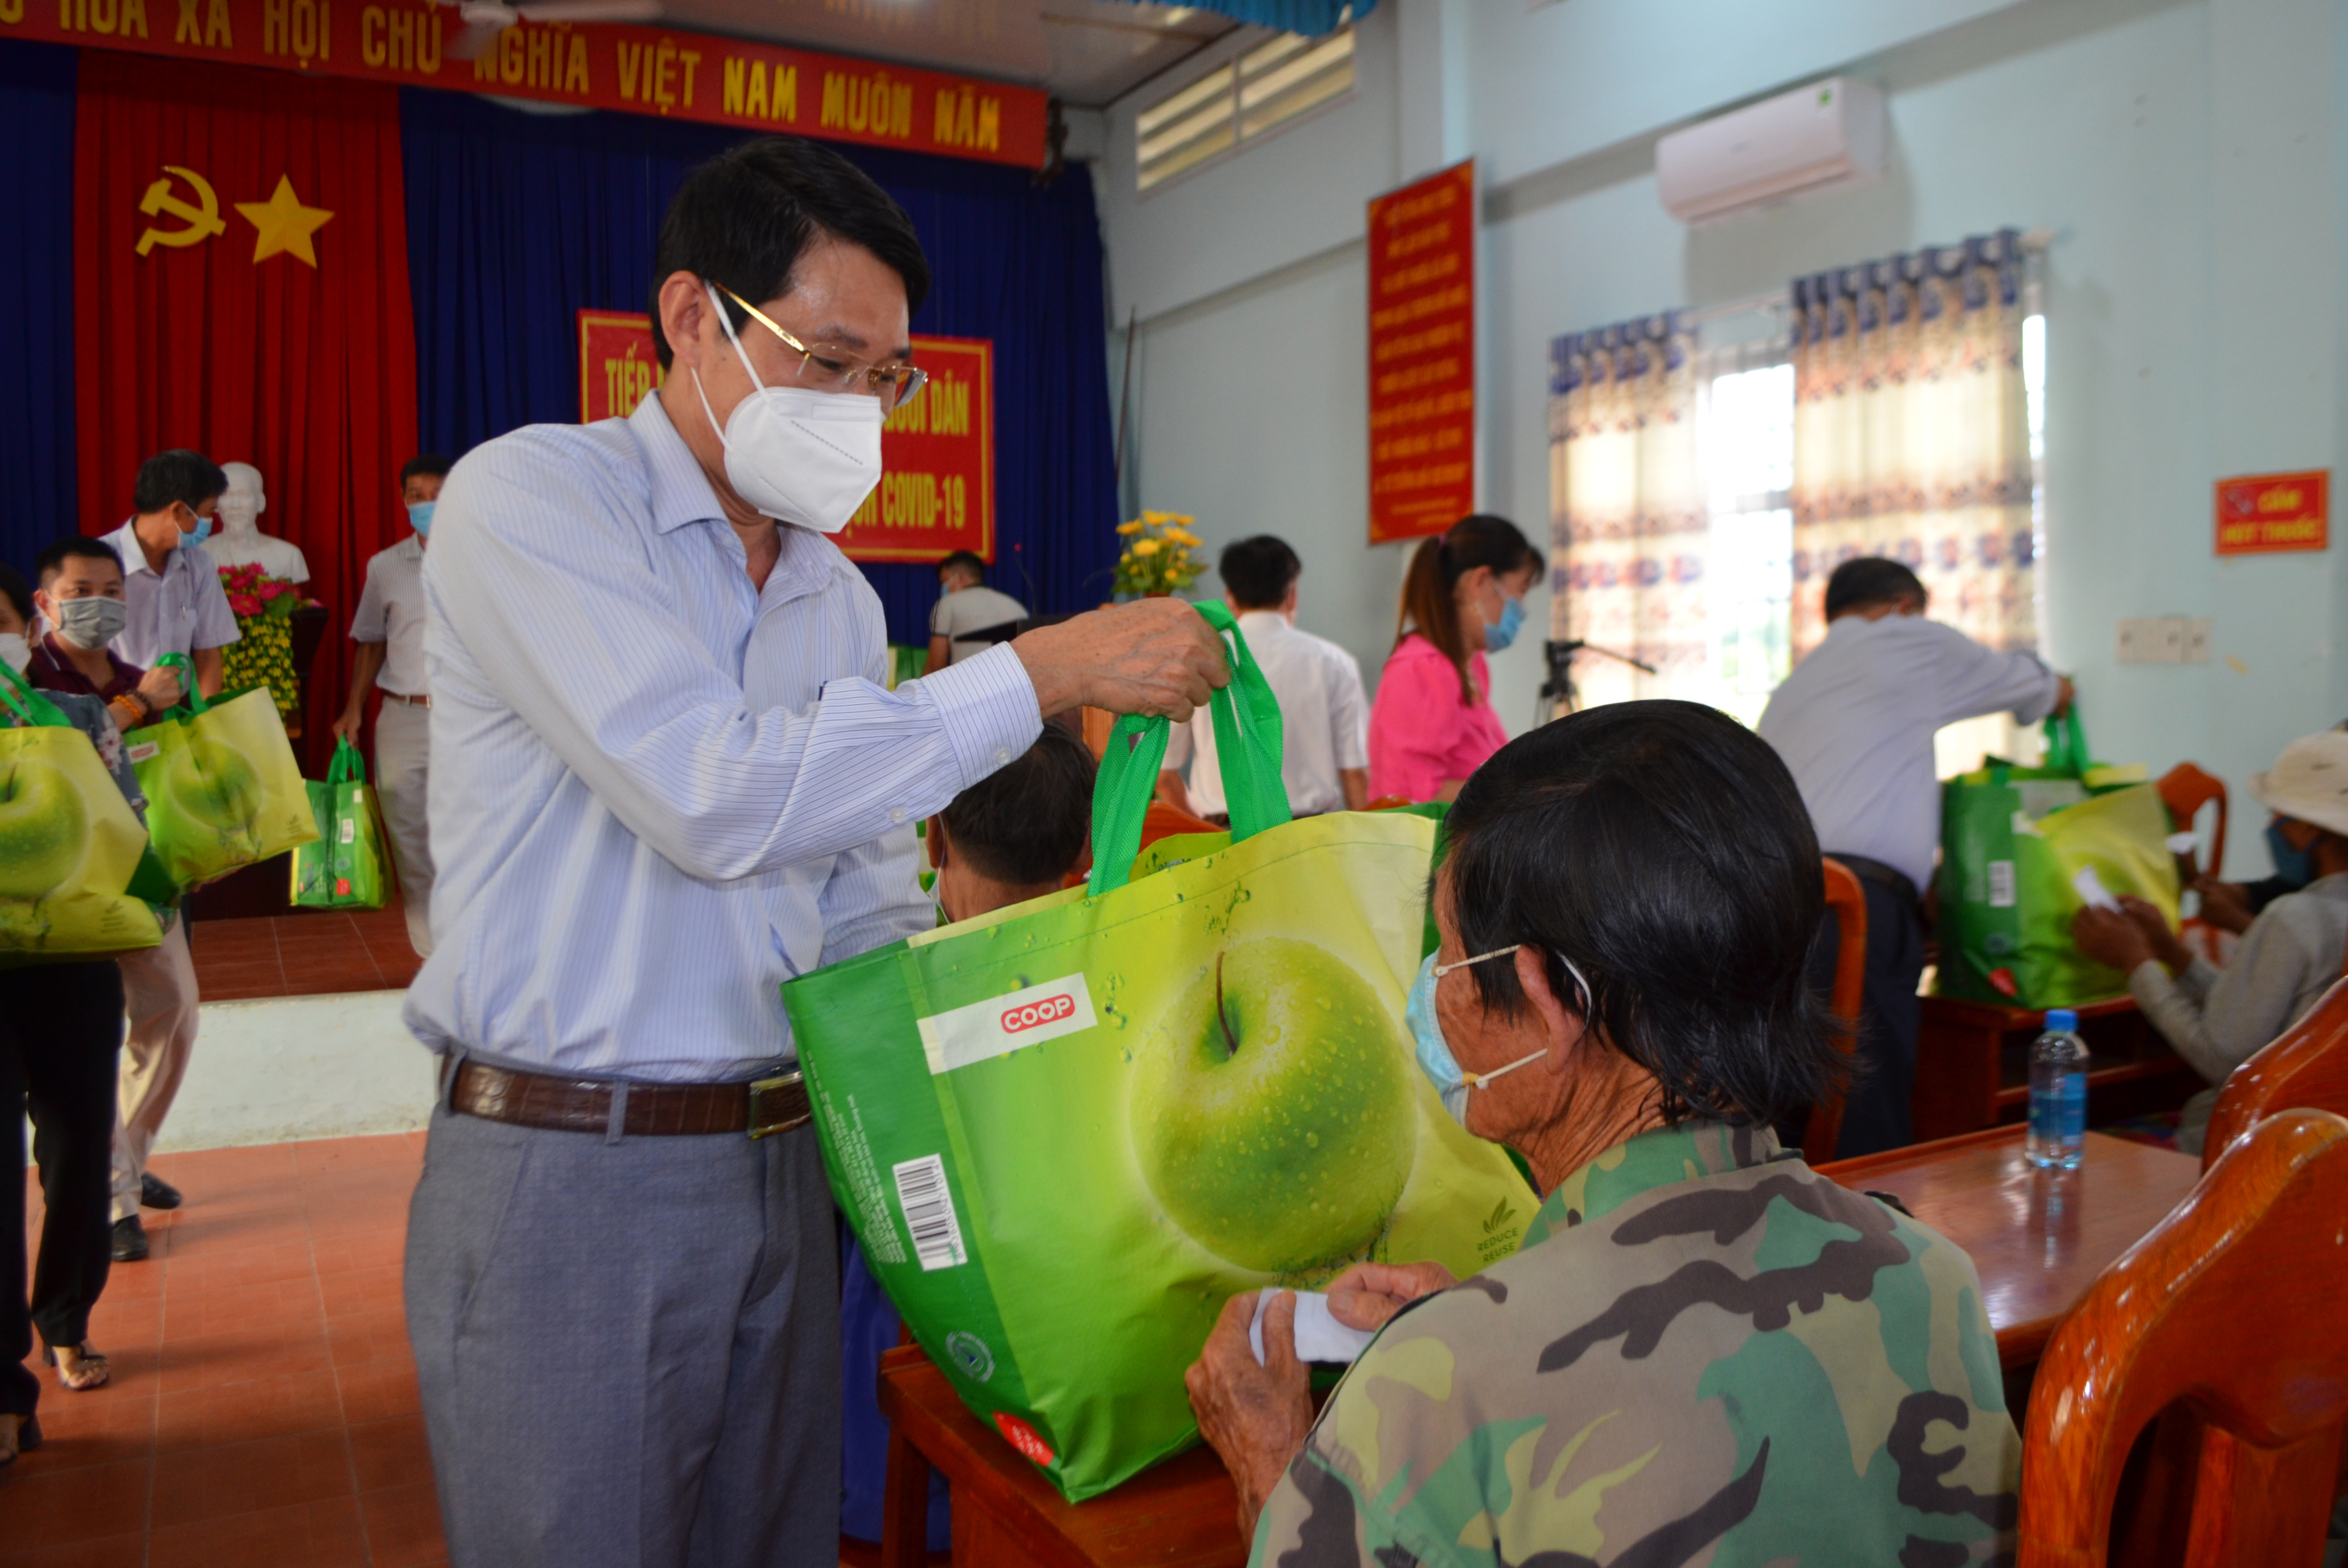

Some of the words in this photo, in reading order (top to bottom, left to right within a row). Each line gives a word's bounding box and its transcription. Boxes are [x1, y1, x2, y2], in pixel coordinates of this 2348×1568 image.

[617, 37, 701, 115] VIỆT
[723, 56, 796, 123] NAM
[820, 71, 912, 139] MUÔN
[934, 84, 1000, 153] NĂM
[605, 341, 650, 416] TIẾP
[930, 368, 969, 436] DÂN
[882, 470, 965, 529] COVID-19
[1004, 997, 1071, 1030] COOP
[1478, 1227, 1517, 1251] REDUCE
[1483, 1242, 1515, 1261] REUSE
